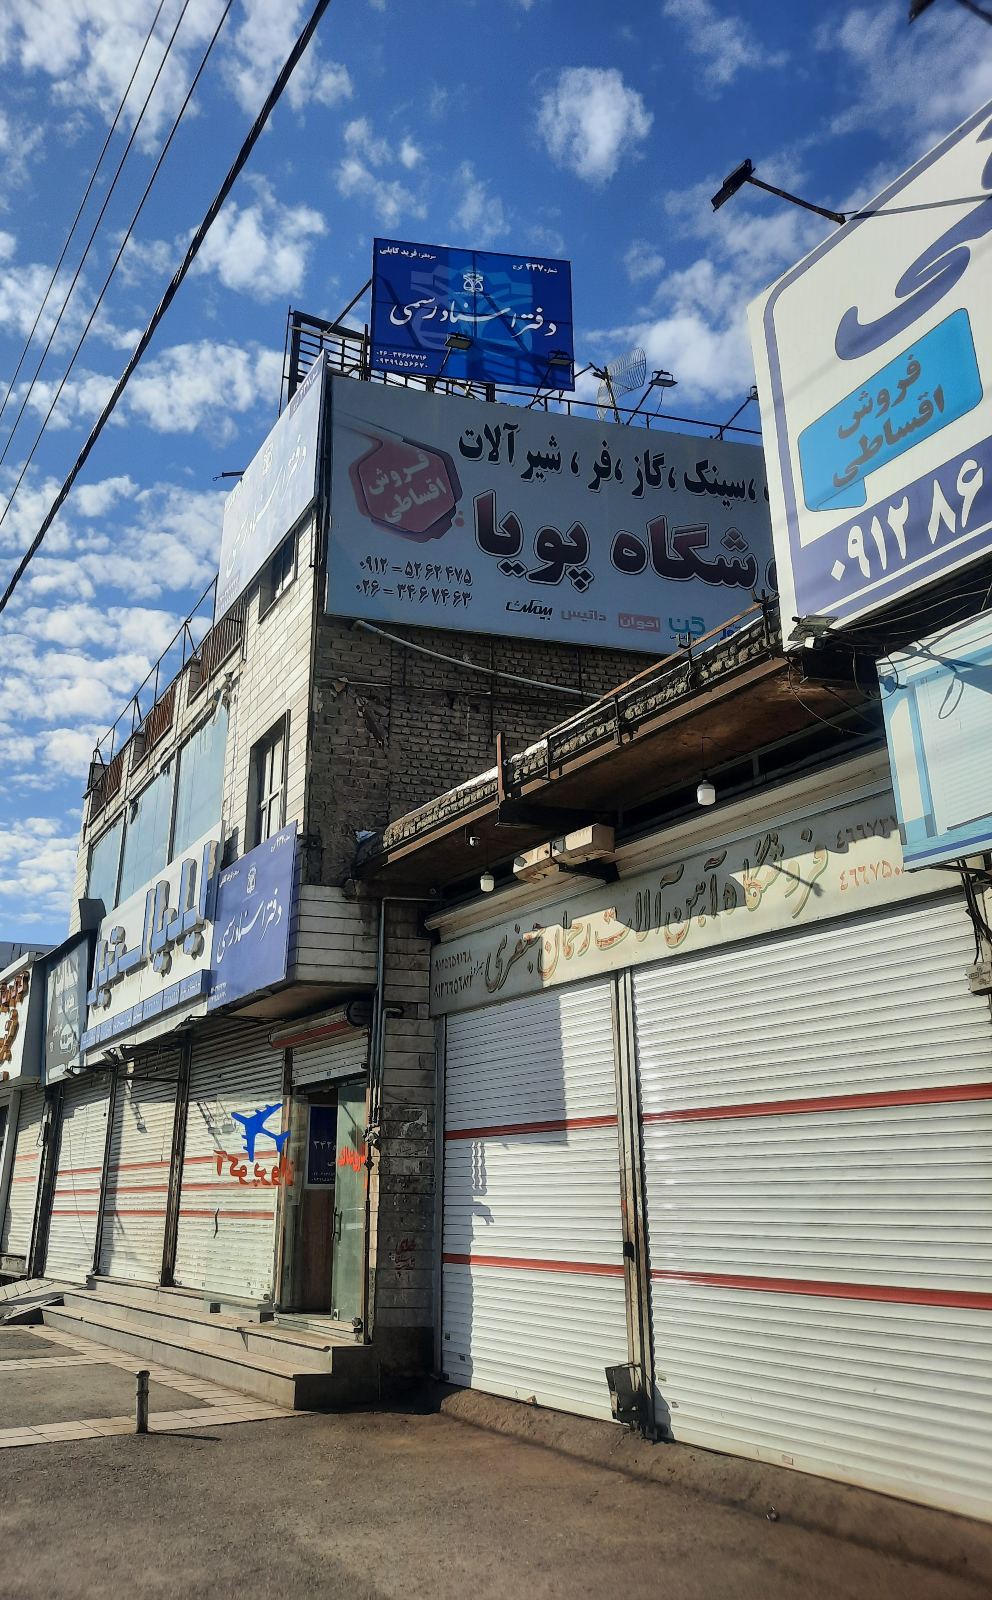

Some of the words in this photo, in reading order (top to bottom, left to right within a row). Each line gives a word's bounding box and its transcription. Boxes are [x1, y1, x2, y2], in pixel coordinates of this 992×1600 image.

[389, 297, 438, 326] رسمی
[440, 300, 517, 329] اسناد
[511, 307, 557, 338] دفتر
[838, 354, 921, 439] فروش
[458, 422, 519, 465] آلات
[520, 435, 562, 481] شیر
[832, 384, 945, 487] اقساطی
[368, 450, 430, 495] فروش
[384, 477, 447, 523] اقساطی
[473, 489, 595, 593] پویا
[610, 515, 778, 592] شگاه
[830, 496, 909, 582] ۰۹۱۲
[560, 609, 607, 622] داتیس
[619, 615, 660, 630] اخوان
[722, 826, 829, 920] فروشگاه
[258, 887, 283, 943] دفتر
[594, 863, 685, 951] آلات
